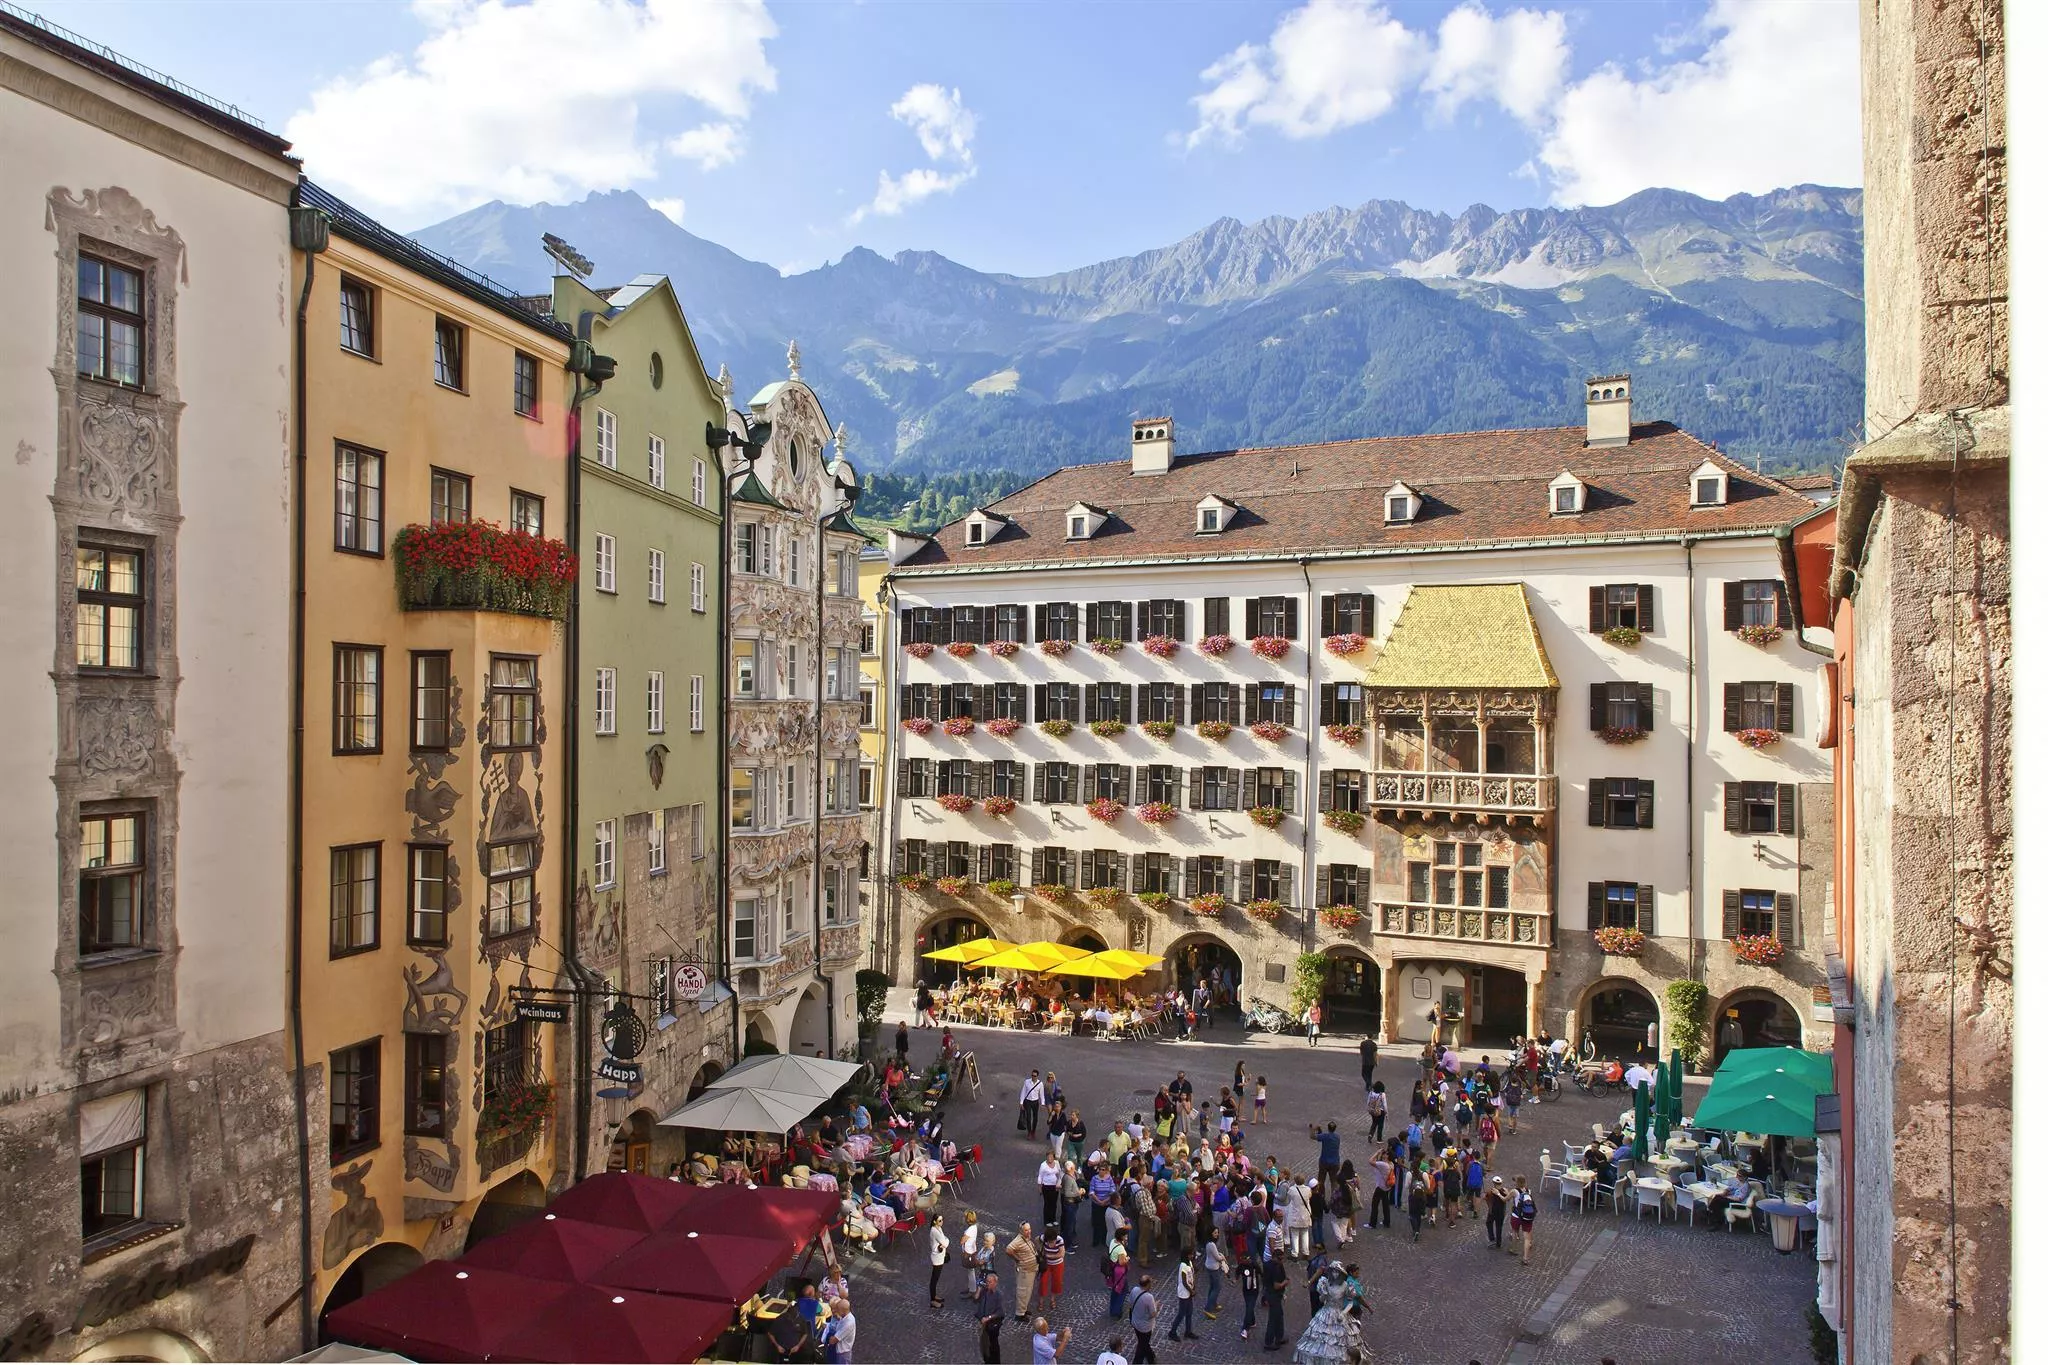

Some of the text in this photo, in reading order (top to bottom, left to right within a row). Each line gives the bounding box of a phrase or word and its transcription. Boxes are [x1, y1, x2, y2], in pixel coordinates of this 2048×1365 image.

[677, 977, 703, 989] HANDL
[519, 1007, 561, 1018] Weinhaus
[602, 1064, 637, 1081] Happ
